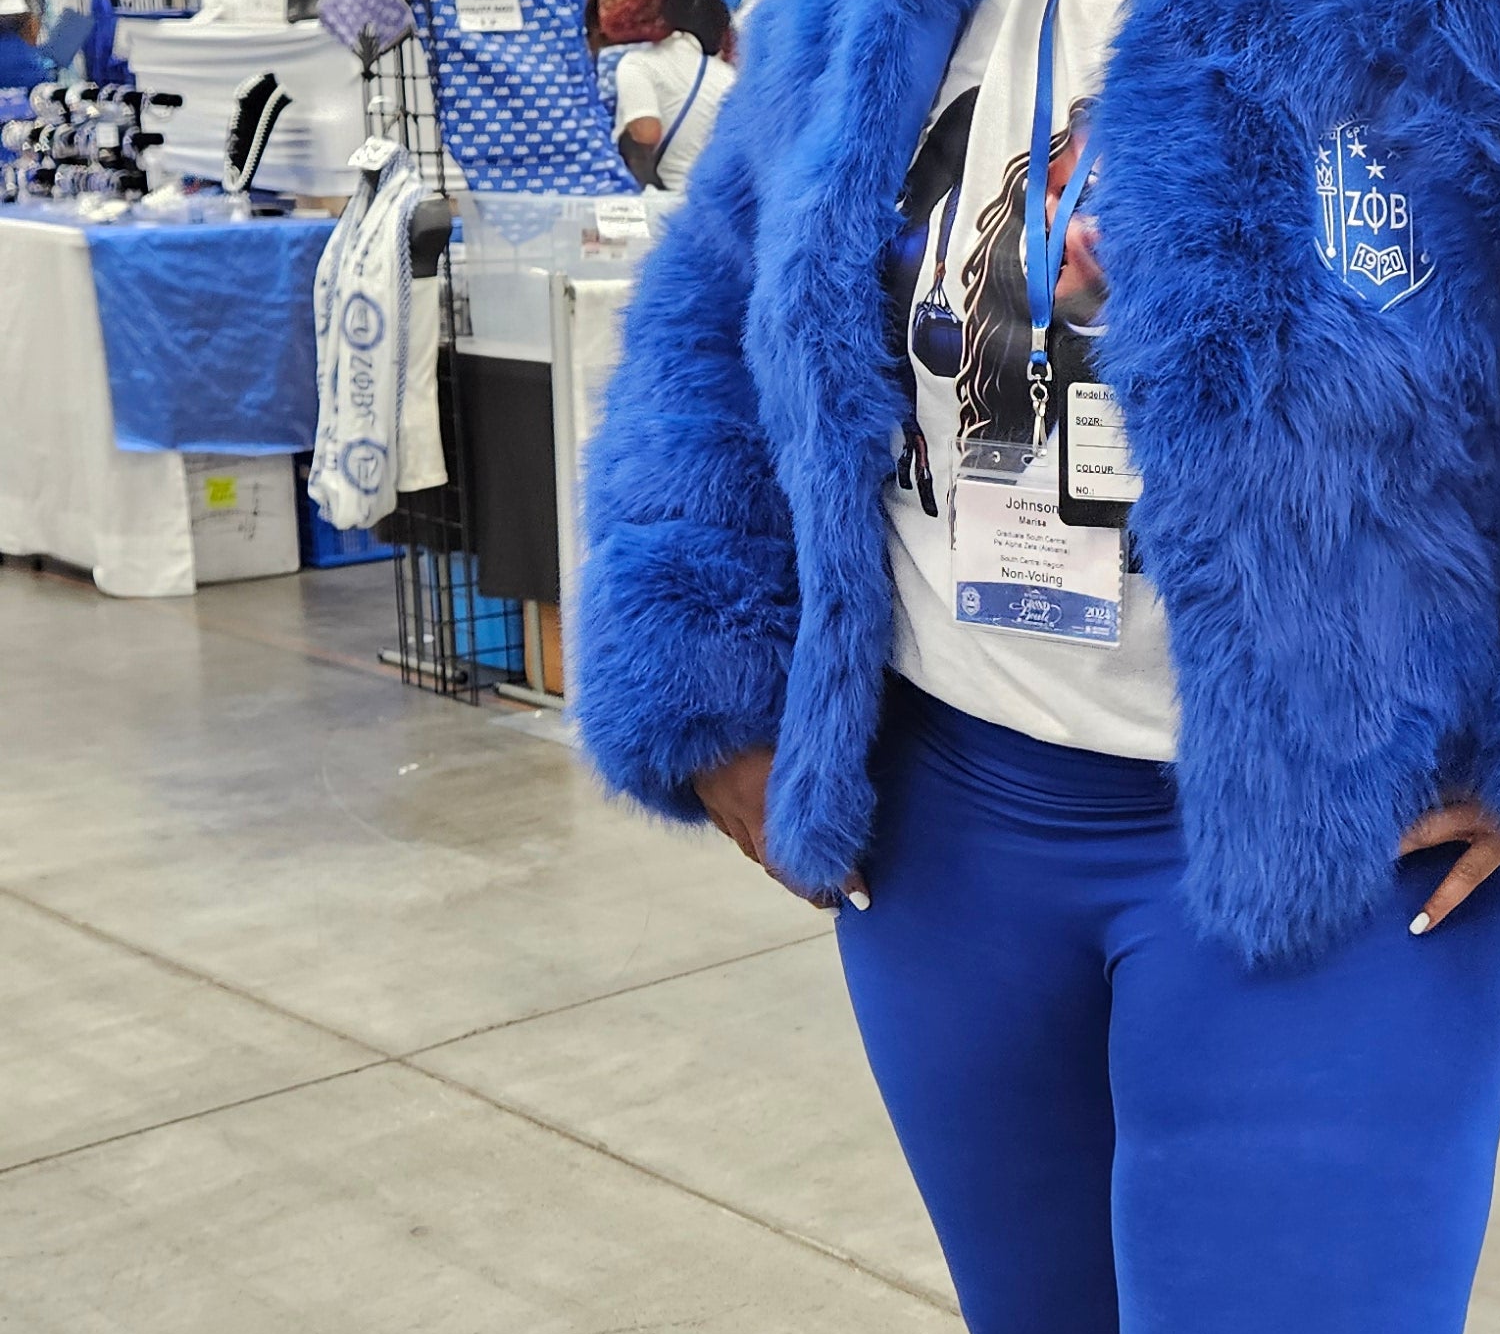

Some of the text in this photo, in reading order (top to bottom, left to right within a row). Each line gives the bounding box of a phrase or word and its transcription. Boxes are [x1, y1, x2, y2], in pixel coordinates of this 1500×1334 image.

[1075, 464, 1115, 475] COLOUR
[1006, 497, 1059, 514] Johnson
[1001, 567, 1063, 587] Non-Voting
